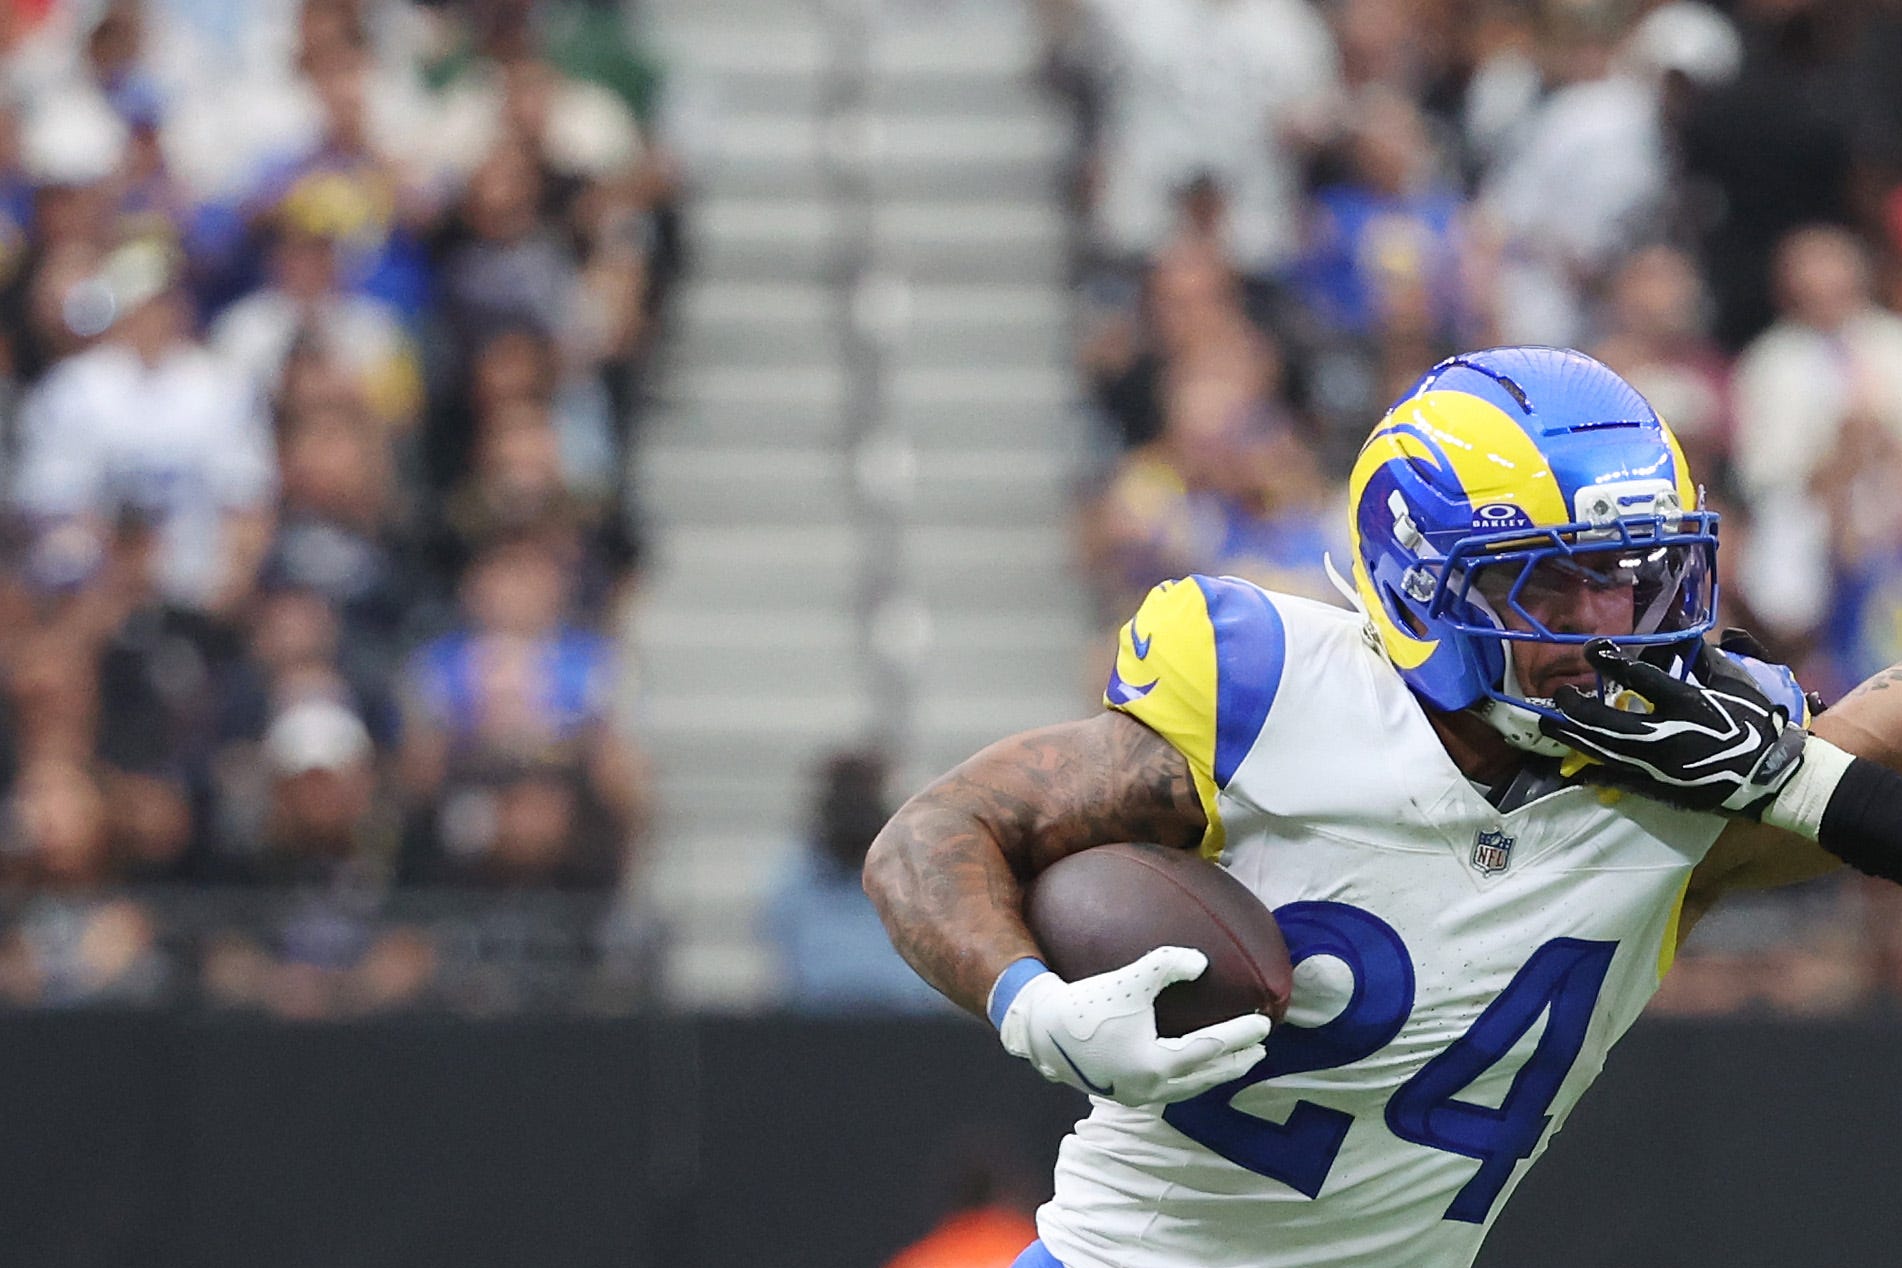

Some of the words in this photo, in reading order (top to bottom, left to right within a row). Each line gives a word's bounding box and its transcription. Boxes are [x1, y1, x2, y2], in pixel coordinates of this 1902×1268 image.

[1472, 519, 1527, 528] OAKLEY
[1475, 845, 1506, 869] NFL
[1162, 900, 1620, 1224] 24
